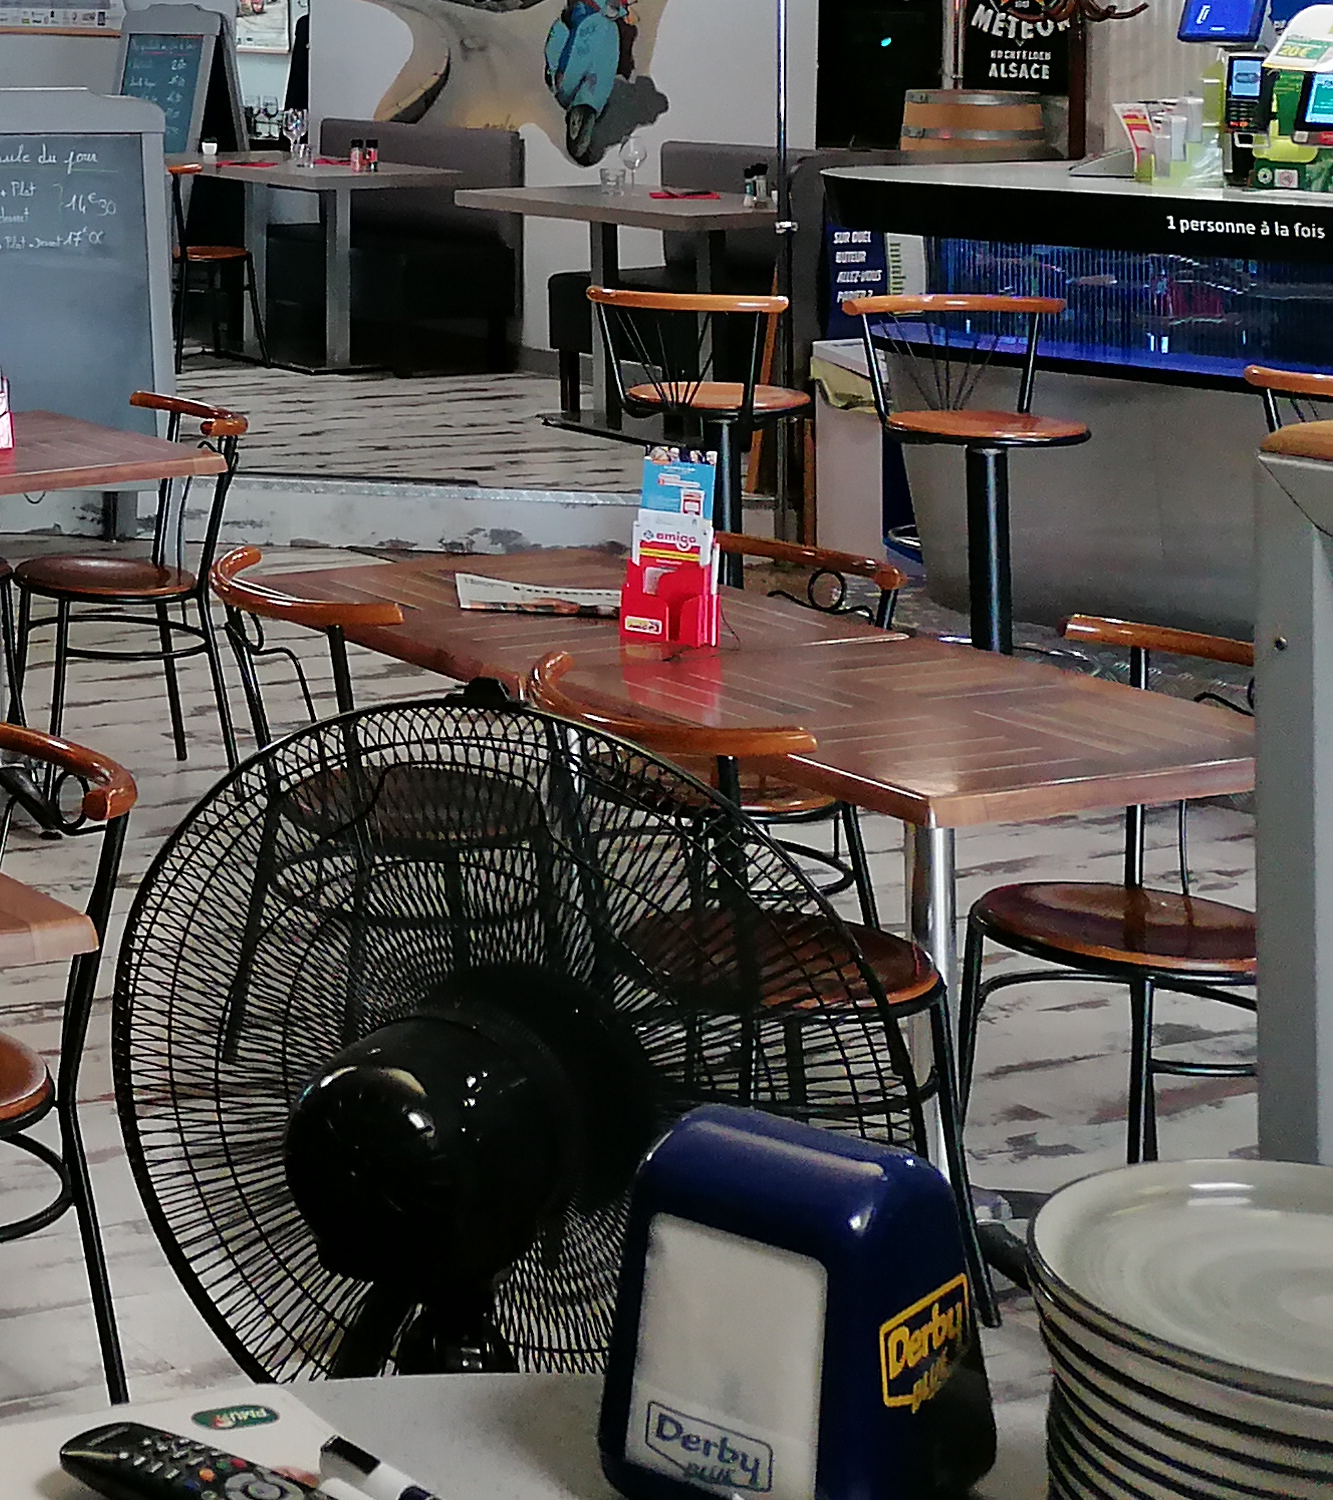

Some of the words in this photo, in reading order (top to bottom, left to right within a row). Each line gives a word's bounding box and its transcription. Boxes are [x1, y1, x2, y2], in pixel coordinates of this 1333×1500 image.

[989, 62, 1050, 79] ALSACE
[38, 143, 57, 164] du
[64, 147, 98, 174] jour
[11, 181, 36, 197] Plat
[1166, 215, 1176, 230] 1
[1179, 219, 1256, 235] personne
[1274, 221, 1290, 237] la
[1294, 222, 1326, 239] fois
[655, 530, 696, 549] amigo
[888, 1302, 963, 1380] Derby
[655, 1412, 760, 1486] Derby
